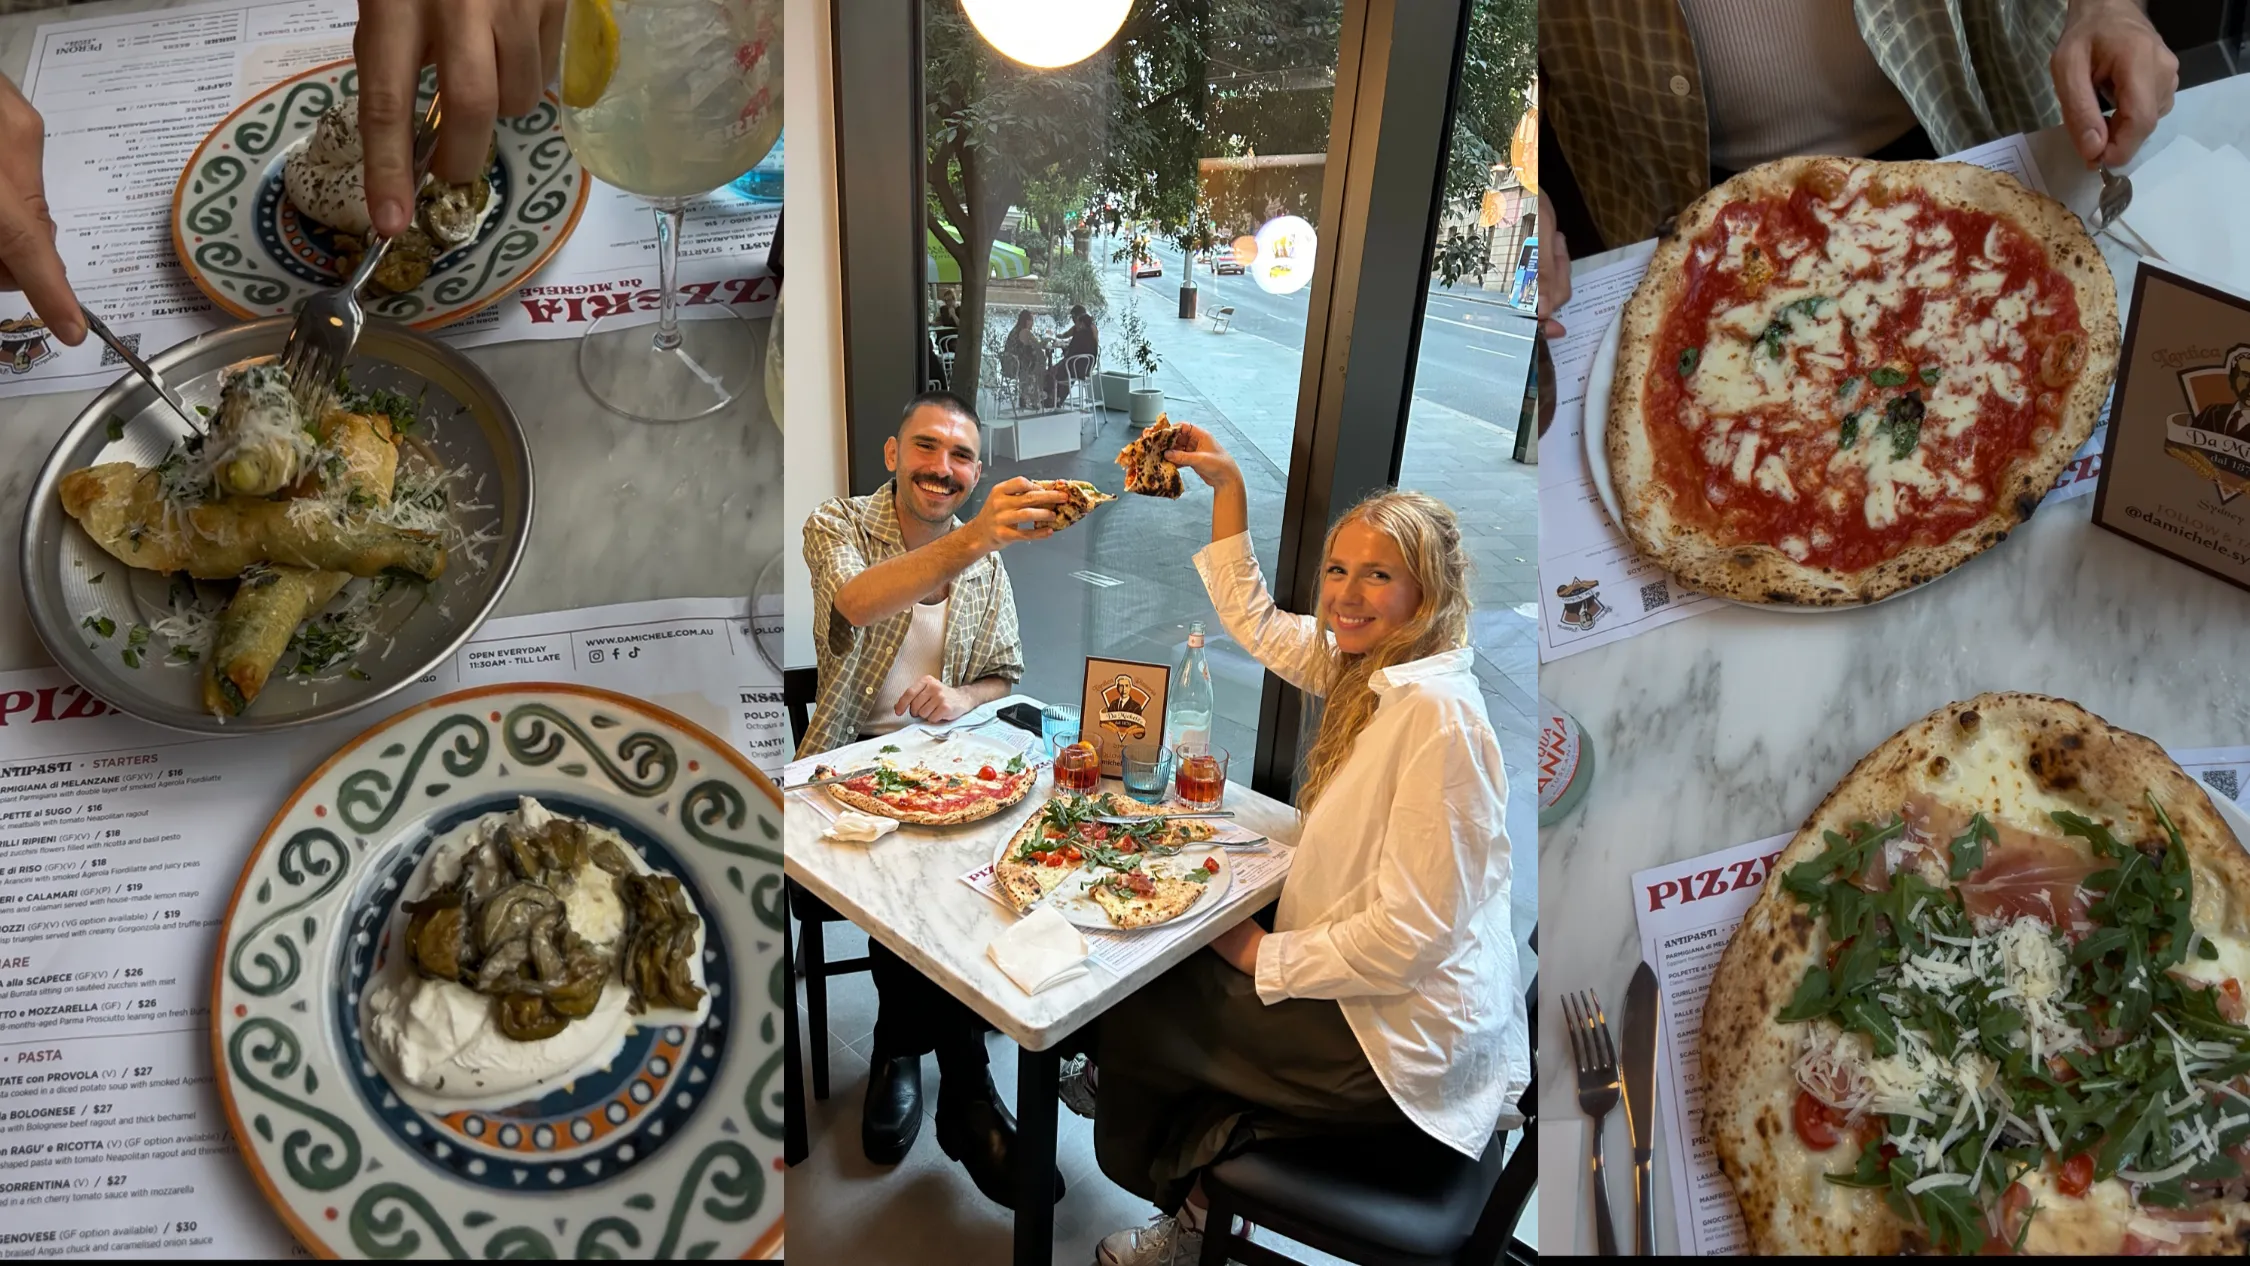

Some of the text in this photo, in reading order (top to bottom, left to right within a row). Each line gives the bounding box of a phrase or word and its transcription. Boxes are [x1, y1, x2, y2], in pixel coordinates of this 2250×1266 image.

[56, 43, 102, 56] PERONI
[126, 189, 173, 201] DESSERTS
[112, 265, 140, 274] SIDES
[618, 278, 643, 290] da
[2186, 429, 2217, 448] Da
[2210, 453, 2228, 466] dal
[2197, 499, 2245, 526] Sydney
[585, 628, 714, 647] WWW.DAMICHELE.COM.AU
[743, 626, 784, 636] FOLLO
[469, 645, 547, 660] OPEN EVERYDAY
[469, 652, 561, 669] 11:30AM TILL LATE
[0, 684, 122, 726] PIZ
[744, 711, 779, 720] POLPO
[746, 721, 779, 730] Octopus
[93, 754, 159, 769] STARTERS
[751, 748, 781, 759] Original
[0, 762, 72, 779] NTIPASTI
[61, 769, 183, 788] MELANZANE (GF)(V) $16
[19, 778, 185, 803] Parmigiana with double layer smoked Agerola
[45, 803, 102, 816] SUGO $16
[8, 808, 149, 829] meatballs with tomato Neapolitan ragout
[22, 828, 120, 845] RIPIENI (GF)(V) $18
[67, 833, 181, 852] filled with ricotta basil pesto
[4, 861, 200, 885] Arancini with smoked Agerola peas
[19, 858, 107, 873] RISO (GF)(V) $18
[26, 883, 143, 902] CALAMARI (GF)(P) $19
[32, 891, 199, 912] calamari served with house-made lemon mayo
[28, 910, 181, 932] (GF)(V) option available) $19
[12, 923, 160, 944] triangles served with creamy Gorgonzola
[1664, 929, 1717, 948] ANTIPASTI
[1665, 945, 1704, 960] PARMIGIANA
[0, 957, 30, 969] ARE
[7, 968, 143, 988] alla SCAPECE (GF)(V) $26
[1668, 966, 1700, 979] POLPETTE
[10, 977, 176, 998] Burrata with mint
[1671, 987, 1697, 999] CIURILLI
[28, 999, 156, 1017] MOZZARELLA (GF) $26
[1674, 1008, 1693, 1018] PALLE
[60, 1008, 188, 1026] Parma Prosciutto leaning fresh
[18, 1050, 62, 1064] PASTA
[47, 1067, 153, 1082] PROVOLA $27
[1683, 1073, 1695, 1082] TO
[10, 1077, 180, 1097] cooked diced potato soup with smoked
[10, 1104, 113, 1120] BOLOGNESE $27
[8, 1112, 196, 1133] with Bolognese beef ragout thick bechamel
[11, 1135, 173, 1155] RAGU' RICOTTA option
[30, 1152, 149, 1169] pasta with tomato Neapolitan
[1693, 1150, 1714, 1160] PASTA
[107, 1176, 127, 1186] $27
[44, 1186, 194, 1205] cherry tomato sauce with mozzarella
[1702, 1214, 1733, 1226] GNOCCHI
[80, 1223, 197, 1241] option available) $30
[5, 1237, 213, 1257] braised Angus chuck caramelised onion sauce
[1706, 1243, 1740, 1257] PACCHERI
